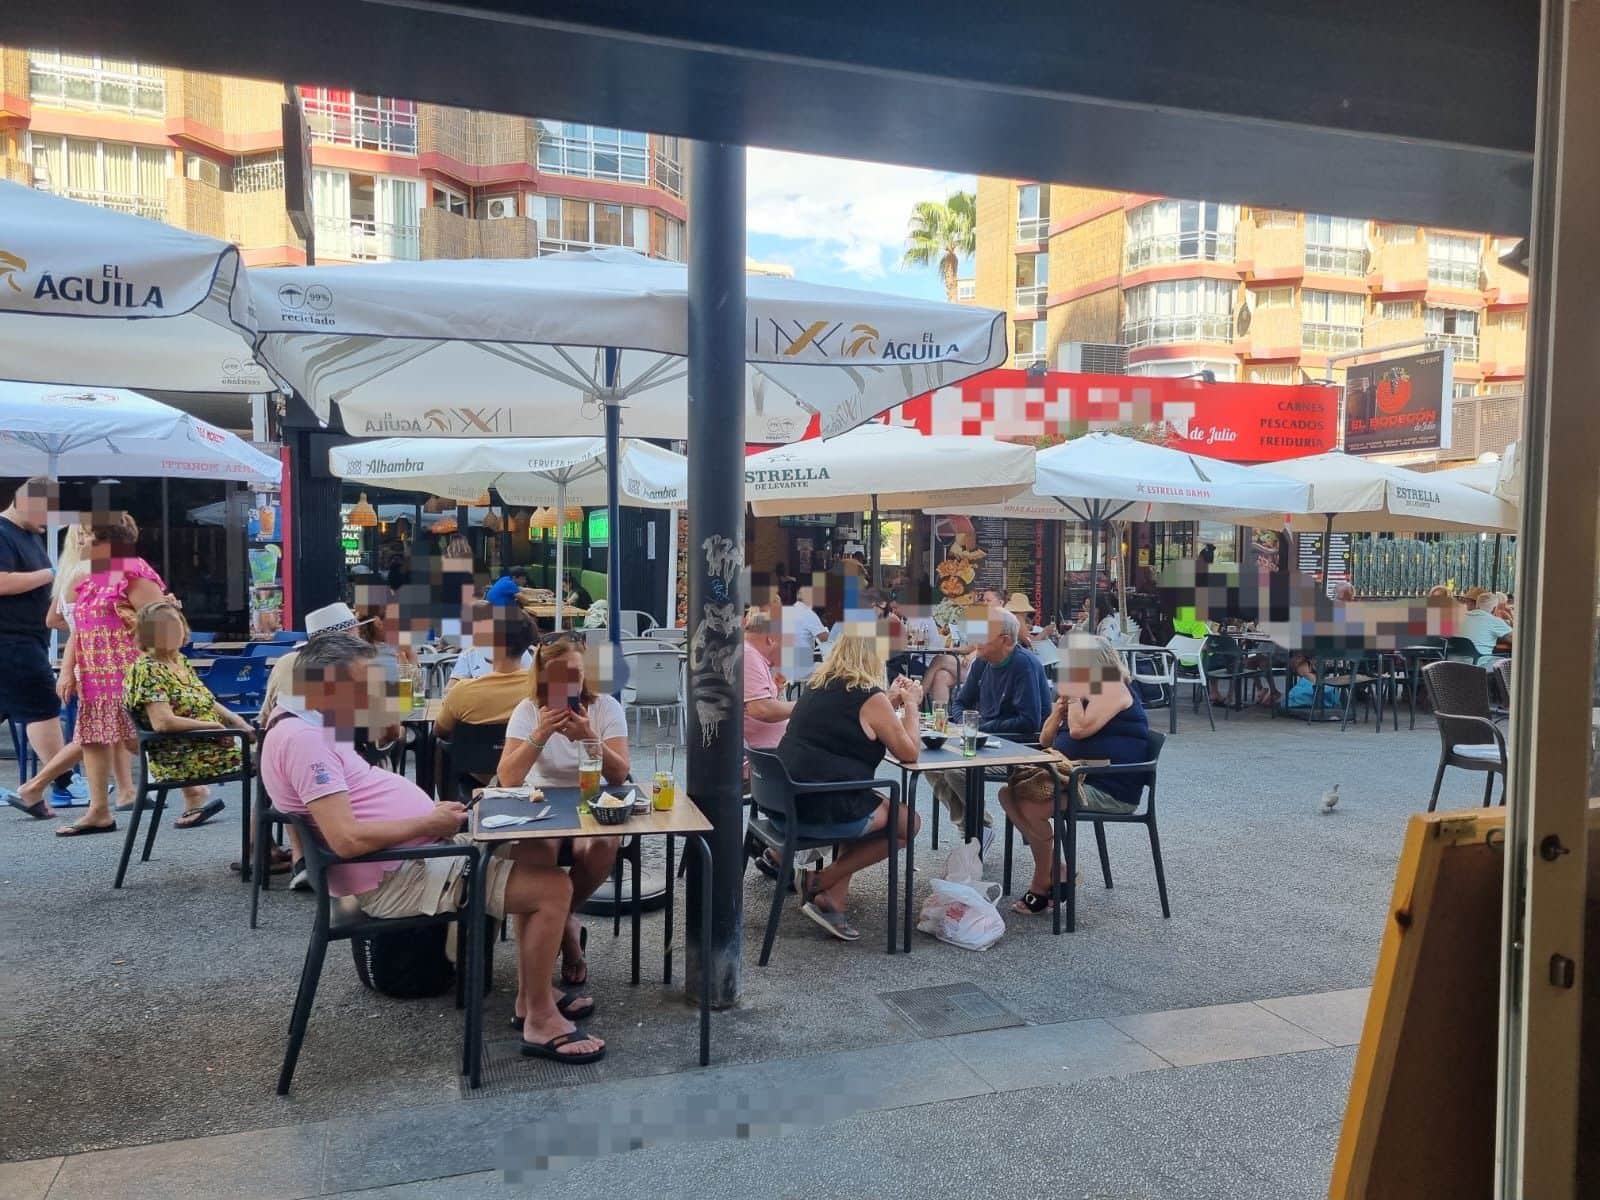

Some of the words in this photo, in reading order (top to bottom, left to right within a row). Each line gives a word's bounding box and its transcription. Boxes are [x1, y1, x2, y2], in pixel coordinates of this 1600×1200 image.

[103, 264, 123, 280] EL
[33, 270, 163, 308] ÁGUILA
[281, 313, 336, 325] reciclado
[922, 332, 935, 344] EL
[1277, 401, 1325, 412] CARNES
[1260, 418, 1325, 431] PESCADOS
[1190, 428, 1204, 441] de
[1206, 426, 1238, 445] Julio
[366, 458, 424, 474] Alhambra
[745, 467, 829, 483] STRELLA
[1147, 486, 1184, 496] ESTRELLA
[1186, 488, 1210, 498] DAMM
[1397, 487, 1440, 503] ESTRELLA
